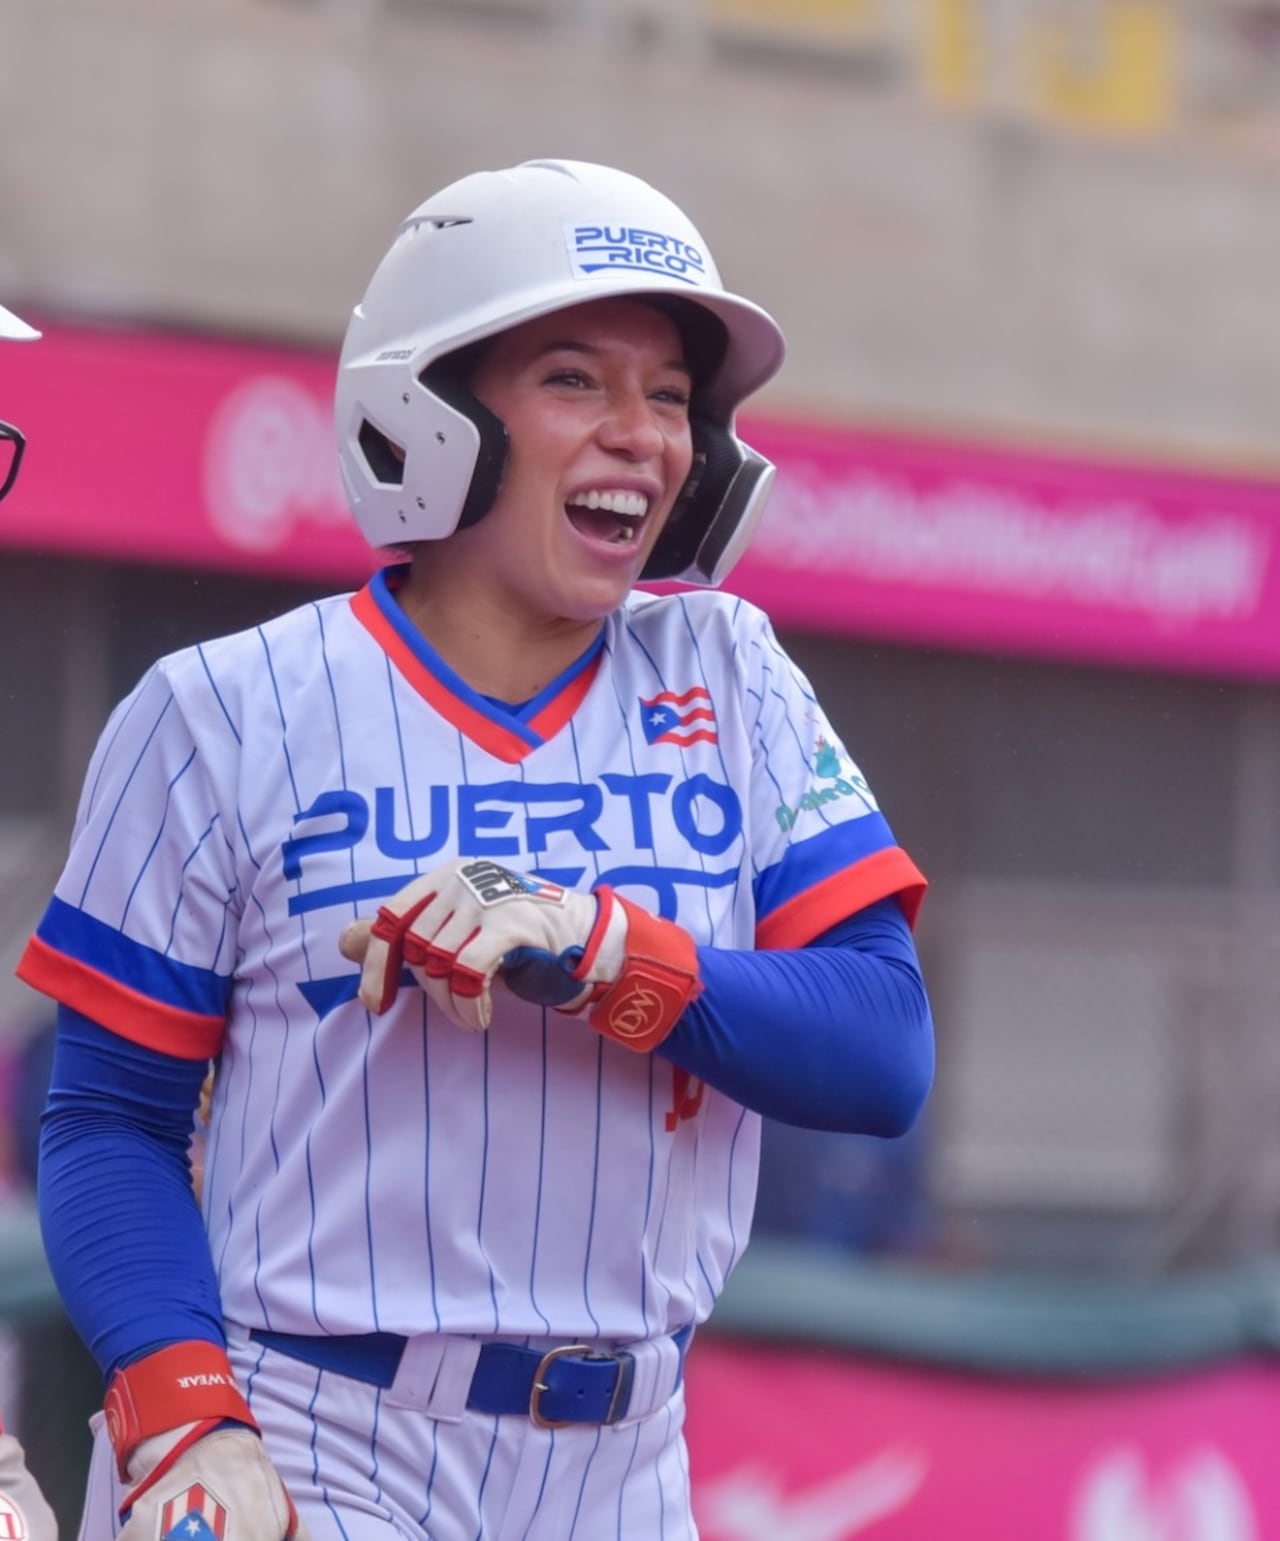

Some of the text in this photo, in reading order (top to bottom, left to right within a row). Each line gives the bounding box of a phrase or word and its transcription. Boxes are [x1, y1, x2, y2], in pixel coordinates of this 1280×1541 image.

[575, 226, 703, 266] PUERTO
[577, 246, 705, 274] RICO
[282, 773, 743, 881] PUERTO
[461, 861, 514, 903] PUR
[176, 1373, 226, 1389] WEAR
